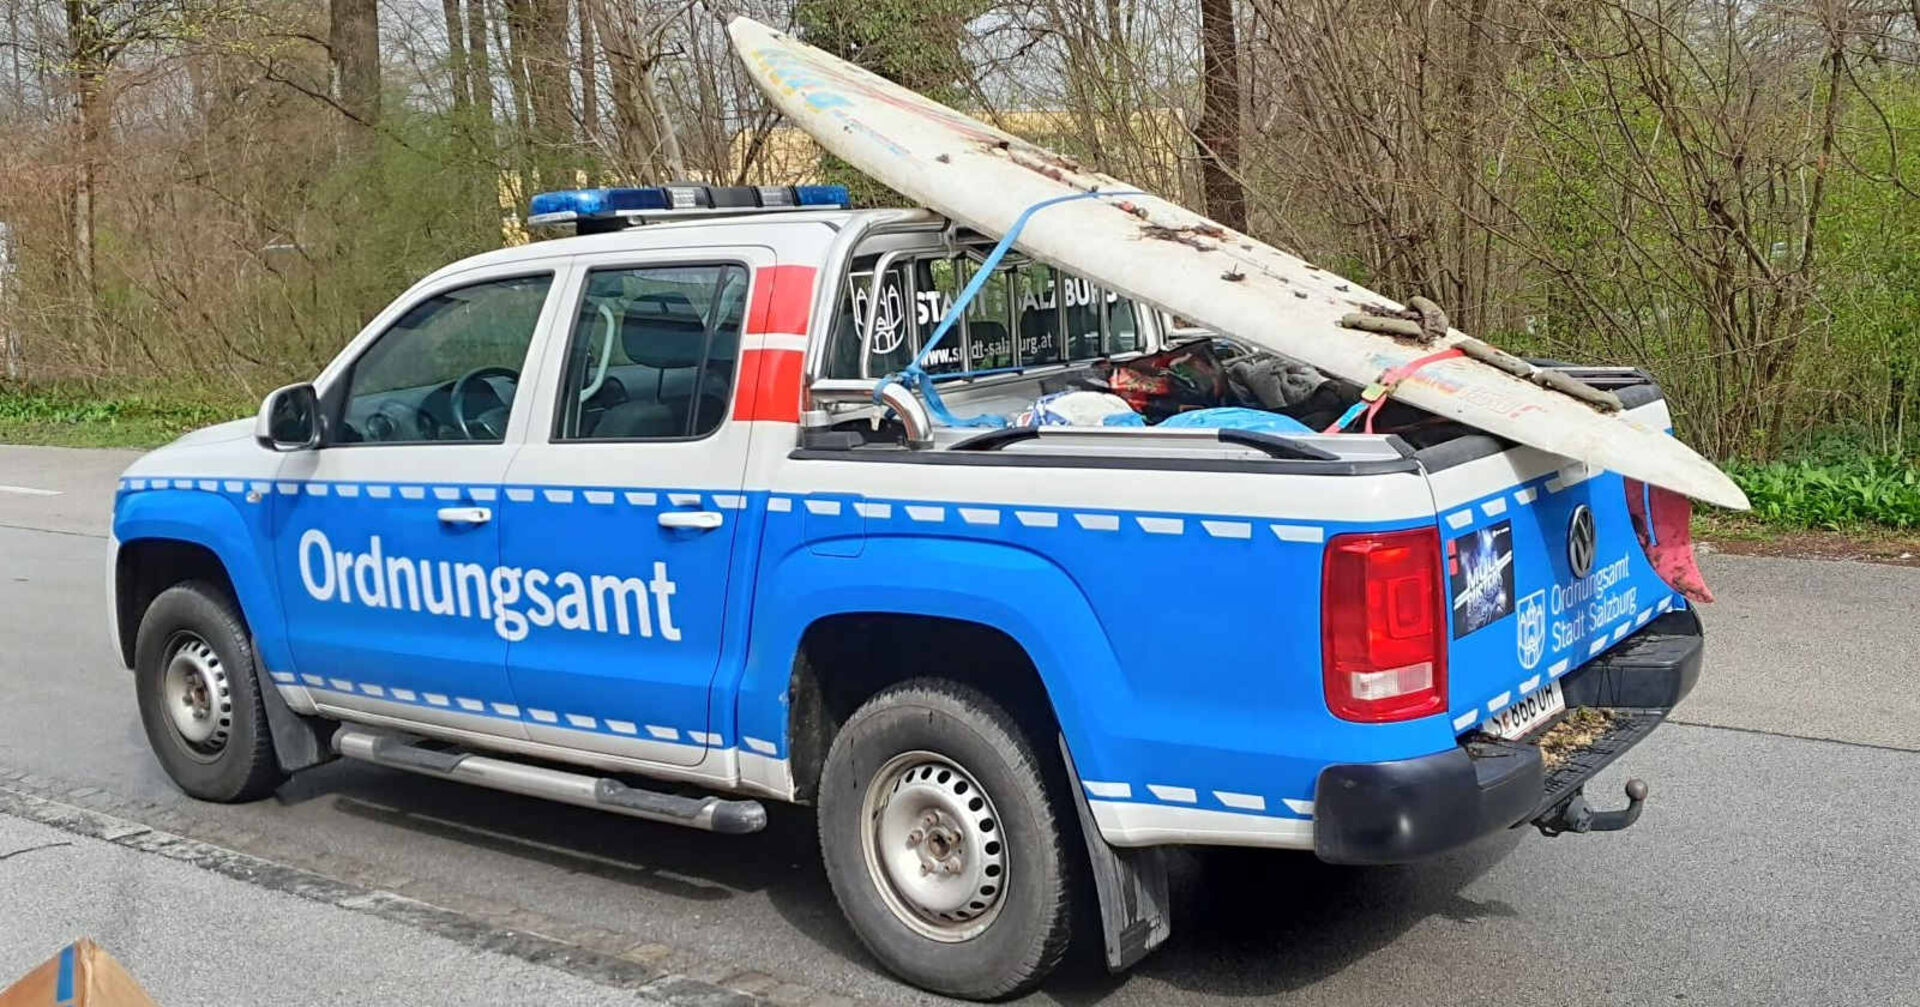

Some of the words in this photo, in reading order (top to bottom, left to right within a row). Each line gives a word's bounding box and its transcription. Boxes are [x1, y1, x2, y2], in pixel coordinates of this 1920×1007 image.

[299, 528, 682, 642] Ordnungsamt
[1551, 553, 1630, 615] Ordnungsamt
[1551, 610, 1586, 652] Stadt
[1588, 586, 1637, 632] Salzburg
